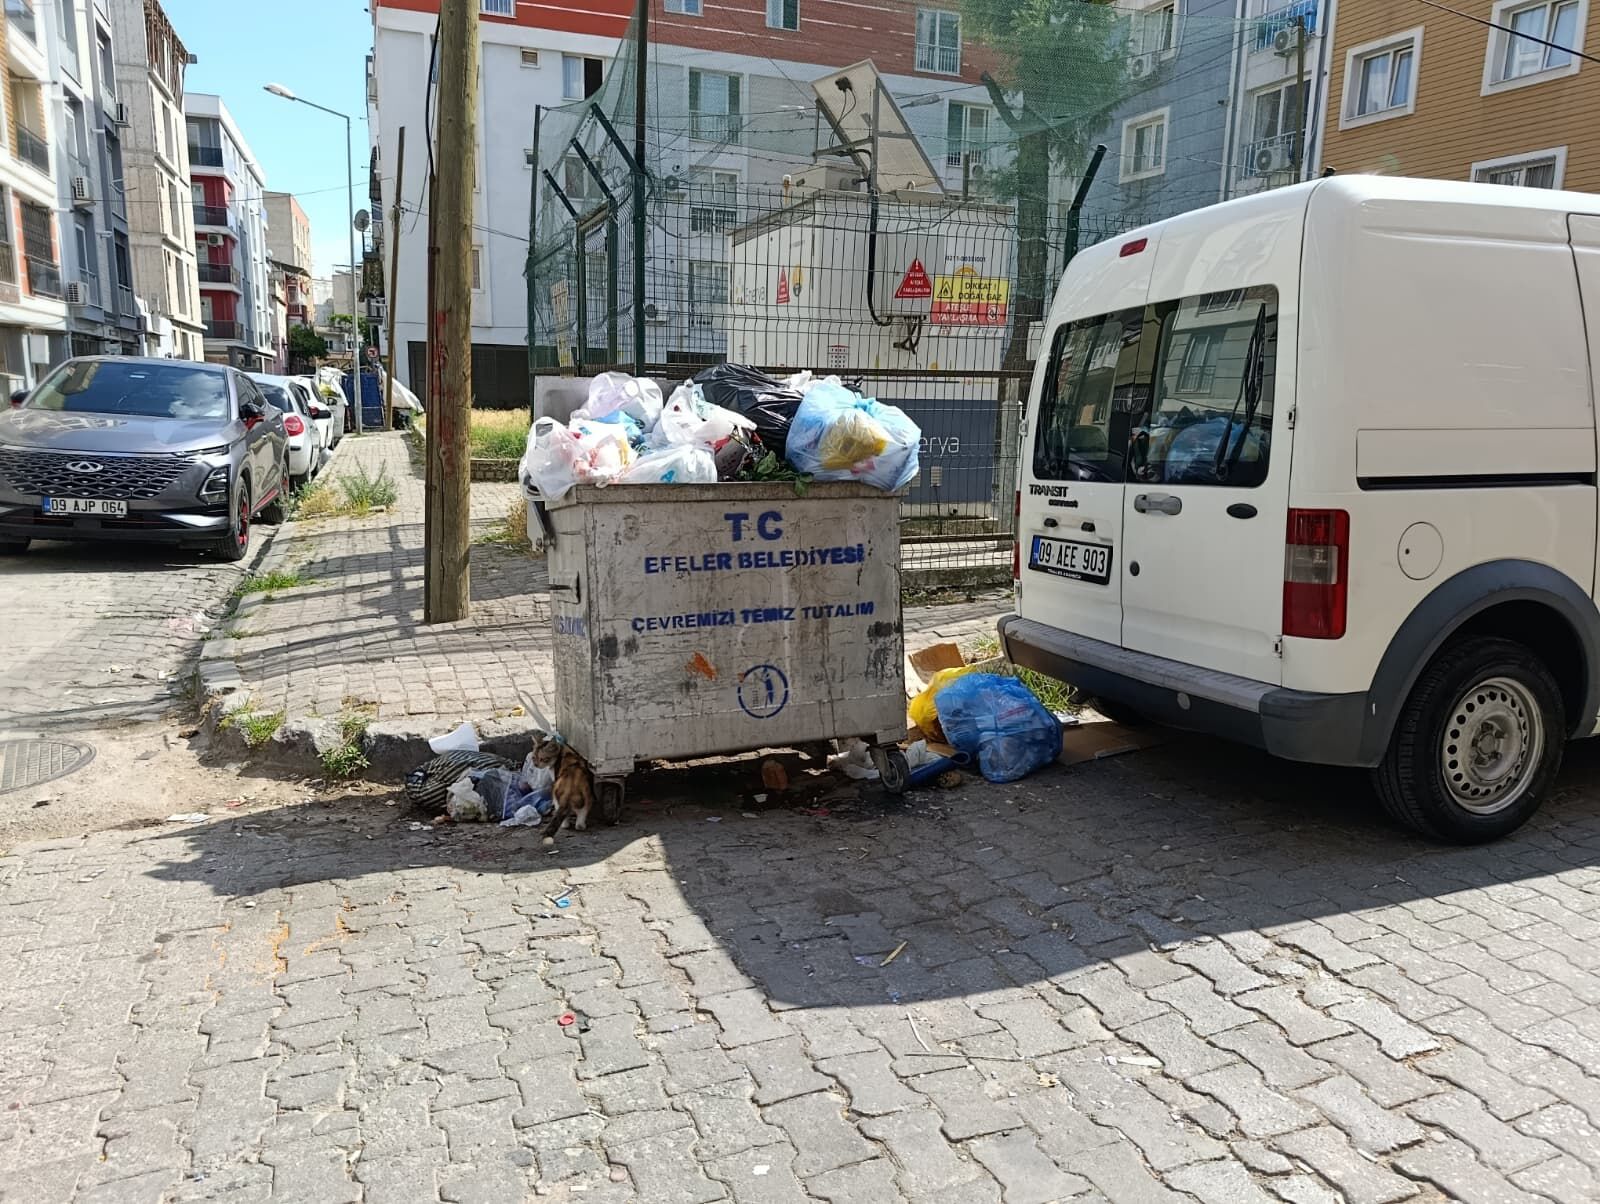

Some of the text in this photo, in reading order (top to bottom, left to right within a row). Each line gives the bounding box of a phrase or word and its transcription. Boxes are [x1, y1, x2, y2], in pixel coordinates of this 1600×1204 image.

[51, 499, 124, 514] 09 AJP 064
[1029, 484, 1069, 498] TRANSIT
[644, 543, 866, 574] EFELER BELEDİYESİ
[1038, 541, 1052, 564] 09
[1056, 544, 1078, 569] AEE
[1082, 548, 1106, 574] 903
[631, 608, 736, 634] ÇEVREMİZİ
[801, 601, 875, 620] TUTALIM
